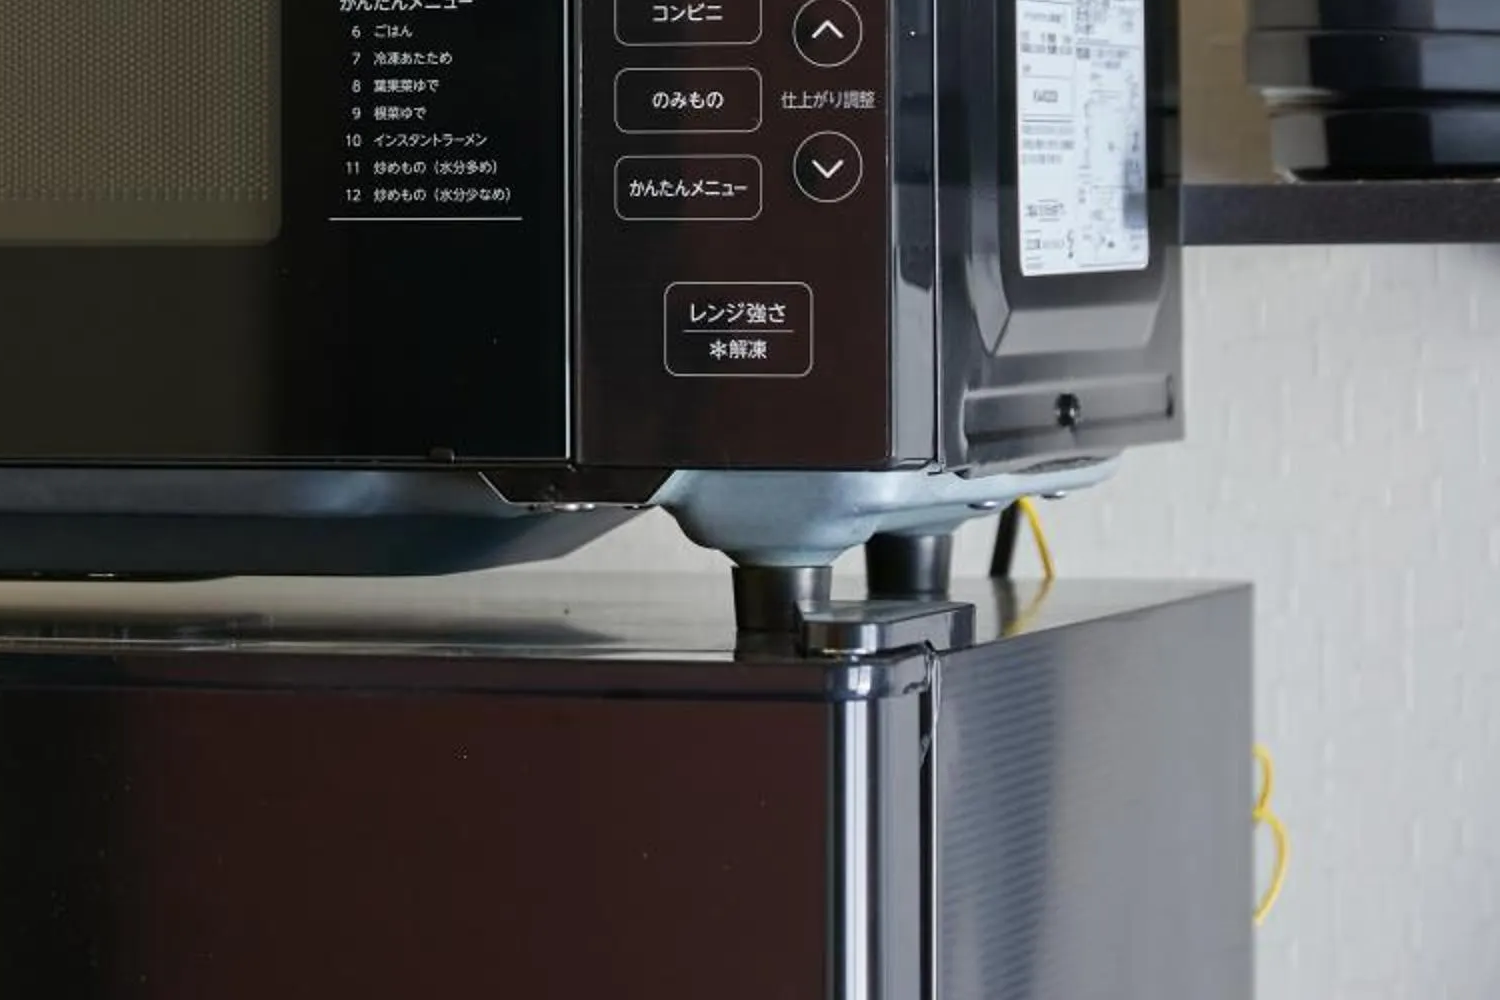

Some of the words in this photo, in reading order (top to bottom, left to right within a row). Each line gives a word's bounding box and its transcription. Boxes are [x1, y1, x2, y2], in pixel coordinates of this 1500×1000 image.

[653, 2, 723, 22] コンビニ
[373, 23, 413, 39] ごはん
[373, 51, 453, 66] 冷凍あたため
[652, 91, 725, 109] のみもの
[780, 90, 876, 109] 仕上がり調整
[373, 105, 427, 121] 根菜ゆで
[373, 133, 488, 148] インスタントラーメン
[629, 179, 748, 198] かんたんメニュー
[690, 302, 786, 324] レンジ強さ
